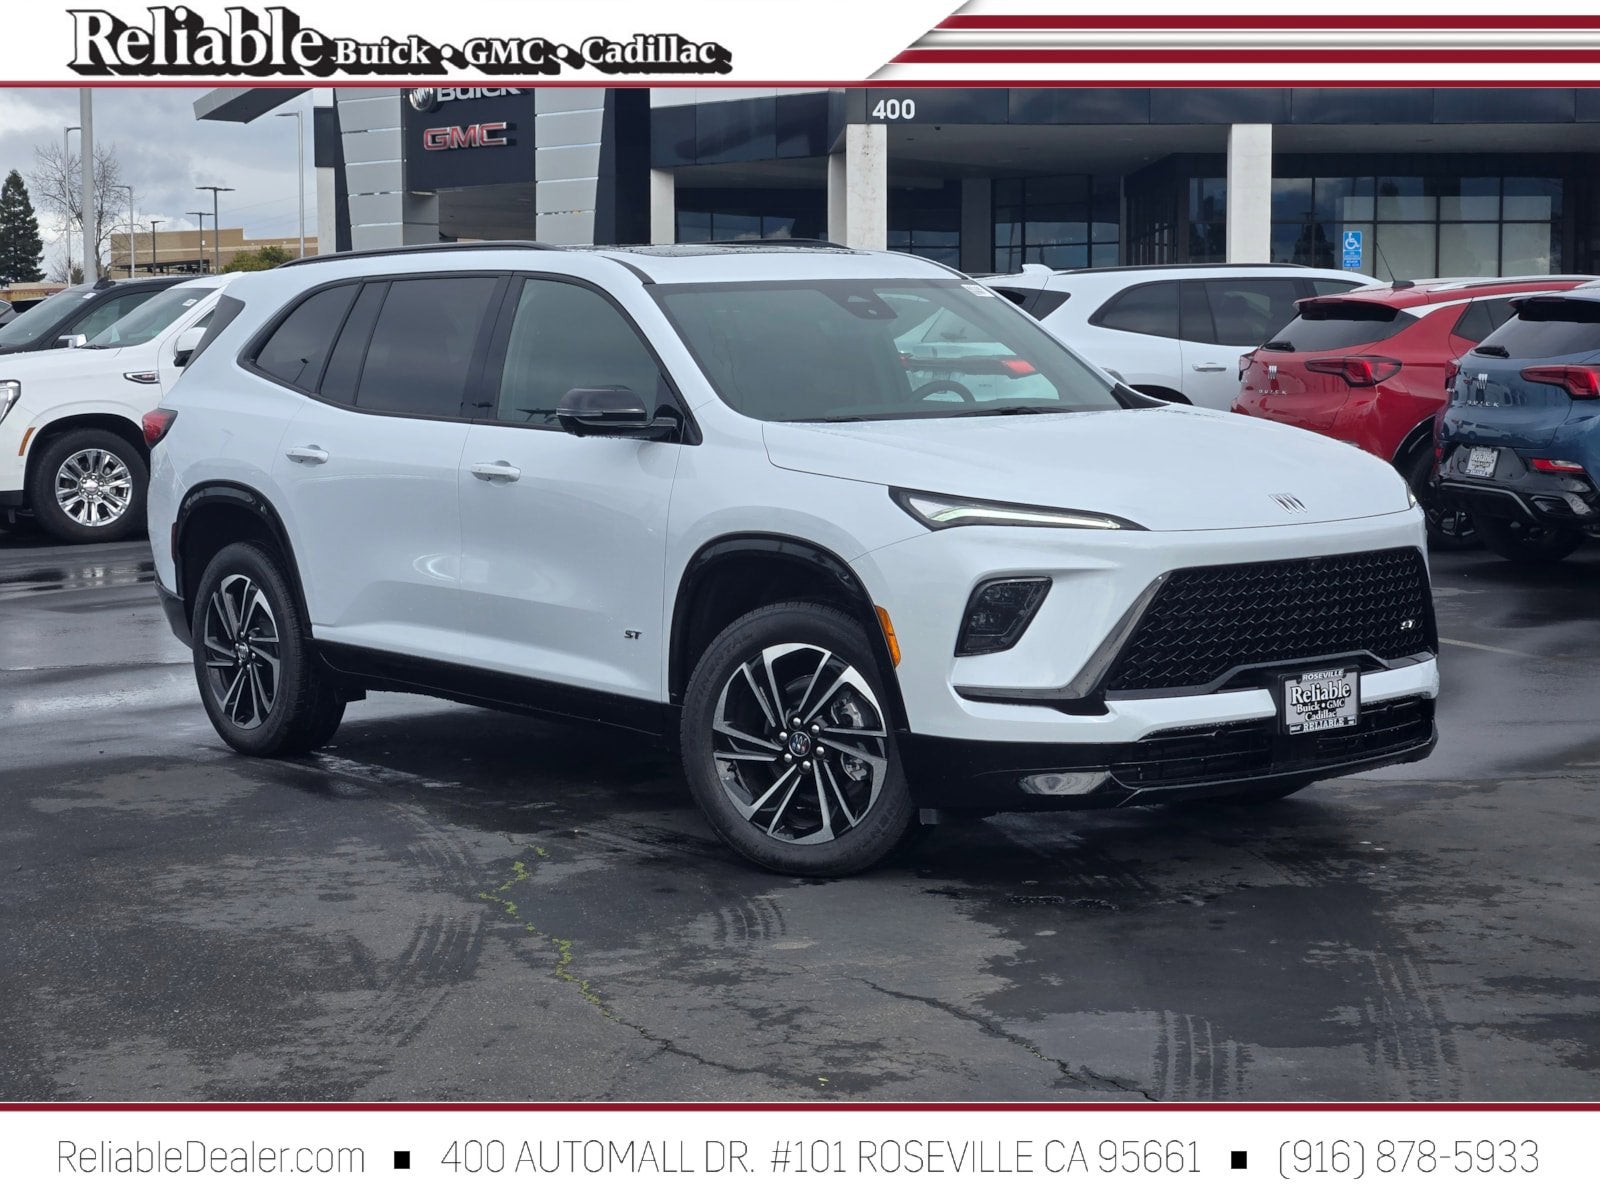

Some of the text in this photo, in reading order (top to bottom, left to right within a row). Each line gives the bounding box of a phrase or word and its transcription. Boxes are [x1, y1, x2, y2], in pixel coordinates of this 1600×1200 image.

[872, 99, 916, 120] 400
[424, 122, 508, 150] GMC
[624, 629, 643, 640] ST
[1302, 668, 1344, 681] ROSEVILLE
[1290, 679, 1351, 706] Reliable
[1297, 698, 1346, 714] Buick GMC
[1305, 709, 1338, 722] Cadillac
[1303, 717, 1344, 732] RELIABLE
